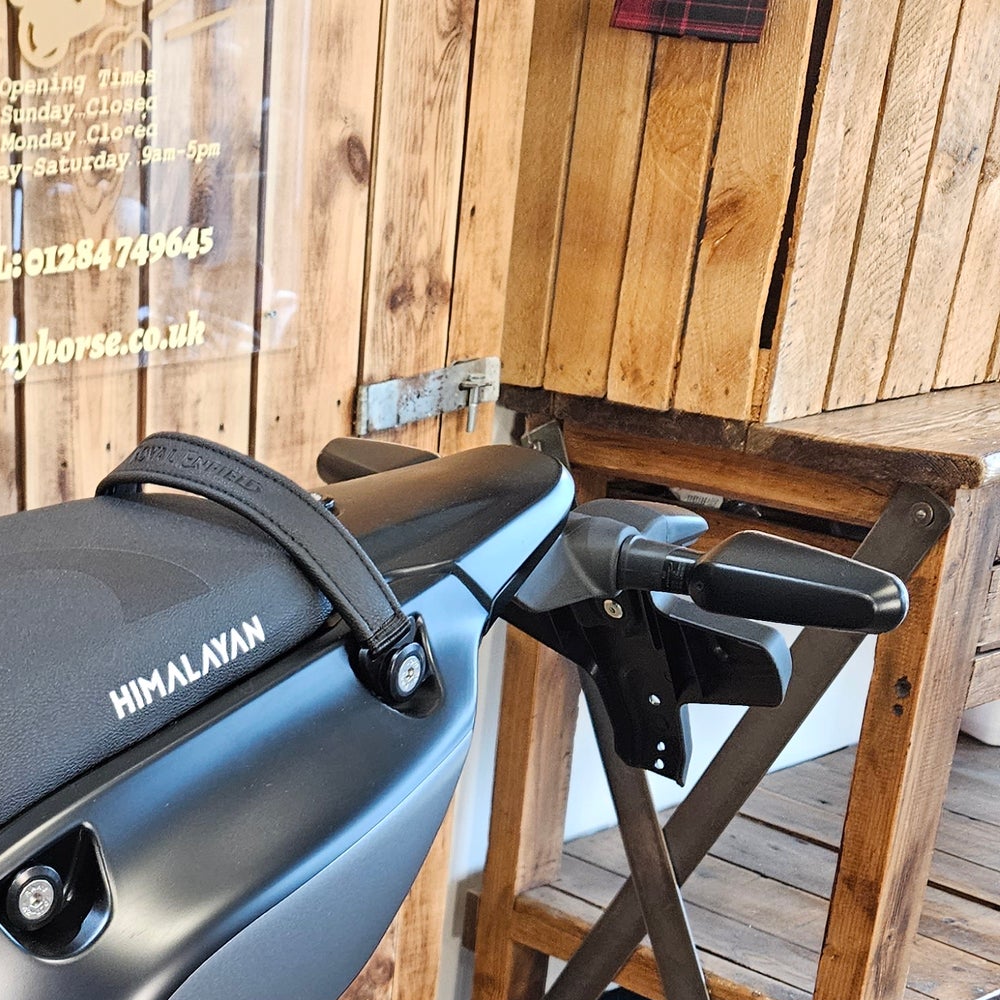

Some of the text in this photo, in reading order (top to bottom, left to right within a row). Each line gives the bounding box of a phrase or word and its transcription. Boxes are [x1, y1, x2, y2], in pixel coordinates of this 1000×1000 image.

[98, 67, 158, 88] Times
[115, 226, 214, 269] 749645
[109, 615, 265, 719] HIMALAYAN
